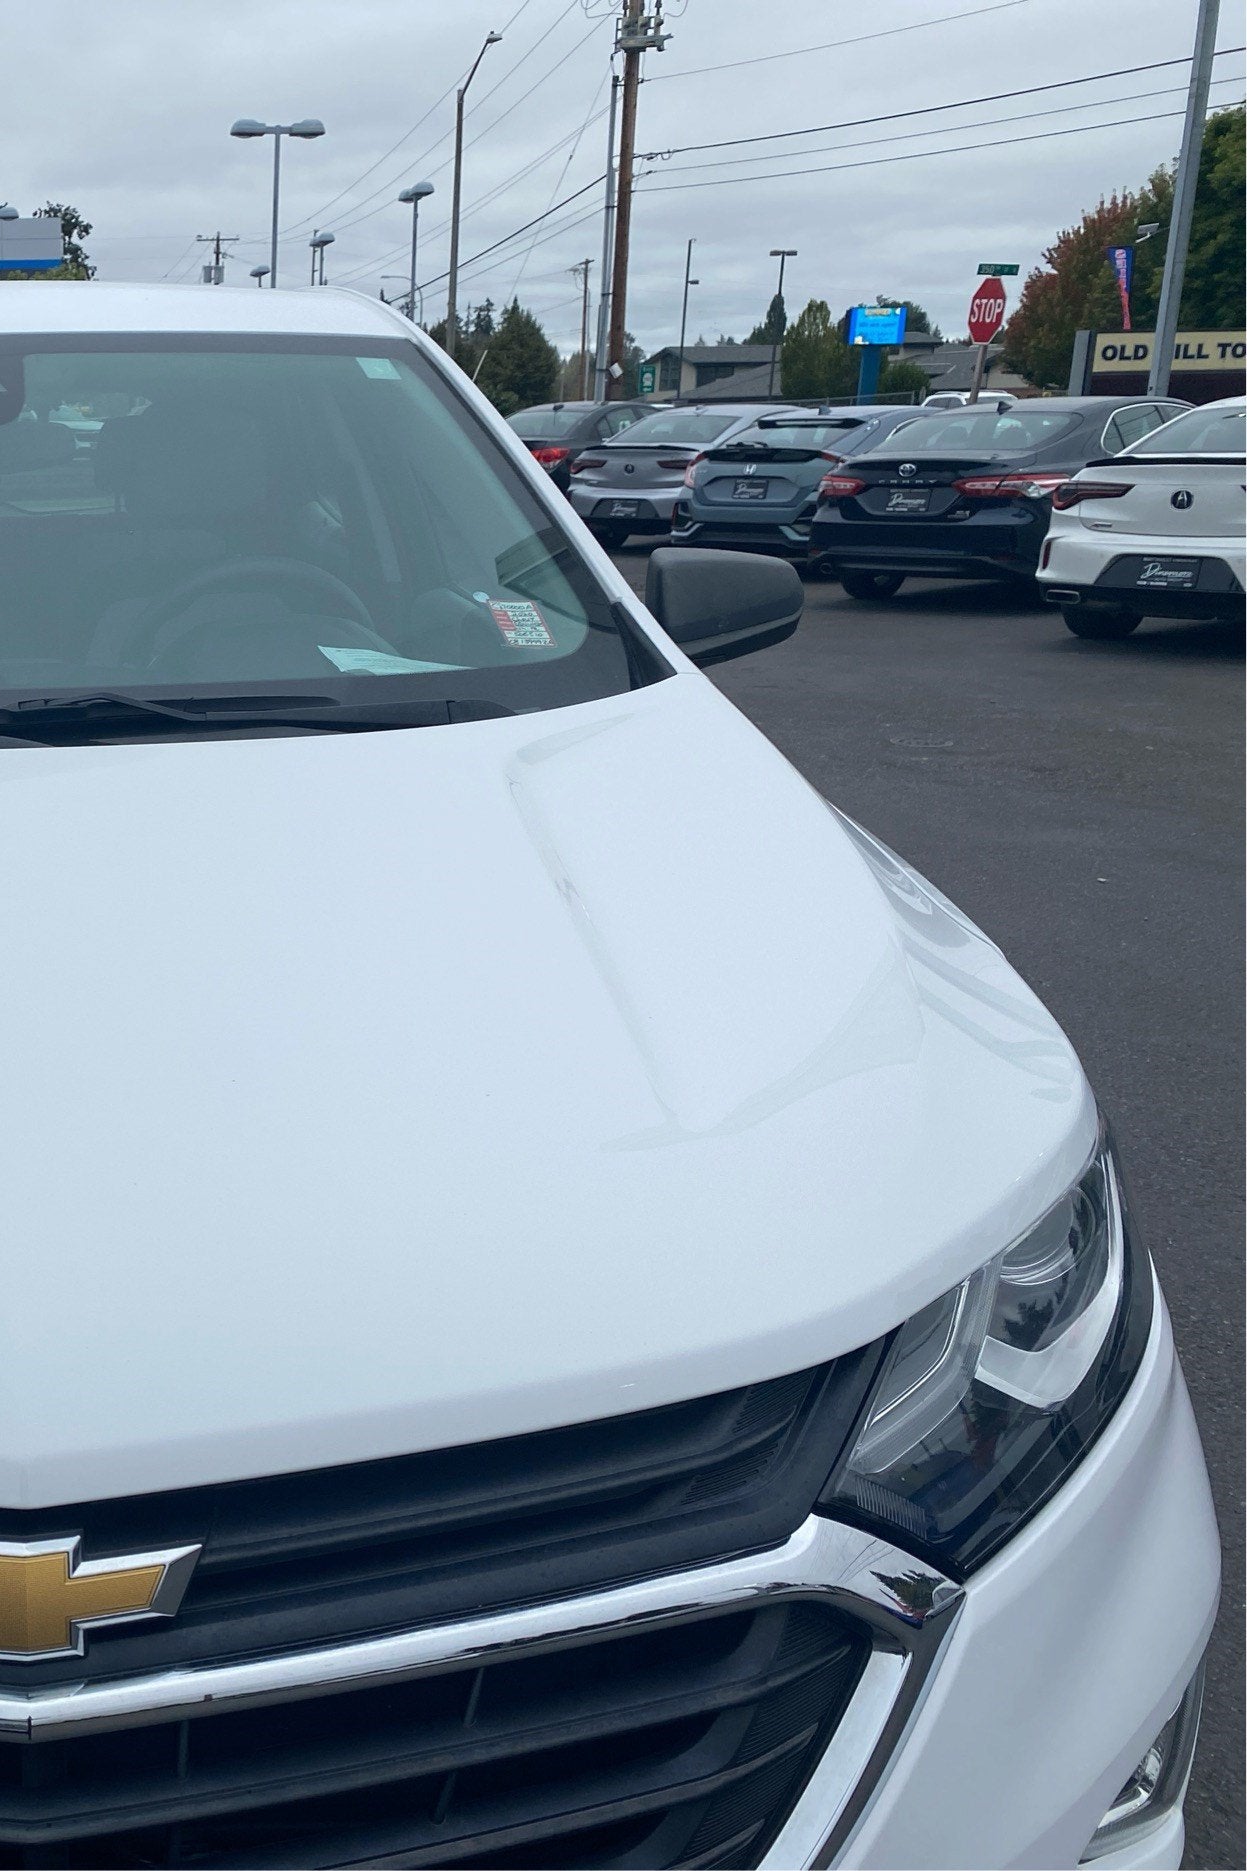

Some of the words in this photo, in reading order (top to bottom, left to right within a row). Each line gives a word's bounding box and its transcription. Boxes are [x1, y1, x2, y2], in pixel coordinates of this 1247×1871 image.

[970, 299, 1004, 324] STOP
[1101, 344, 1149, 361] OLD
[1173, 343, 1209, 359] ILL
